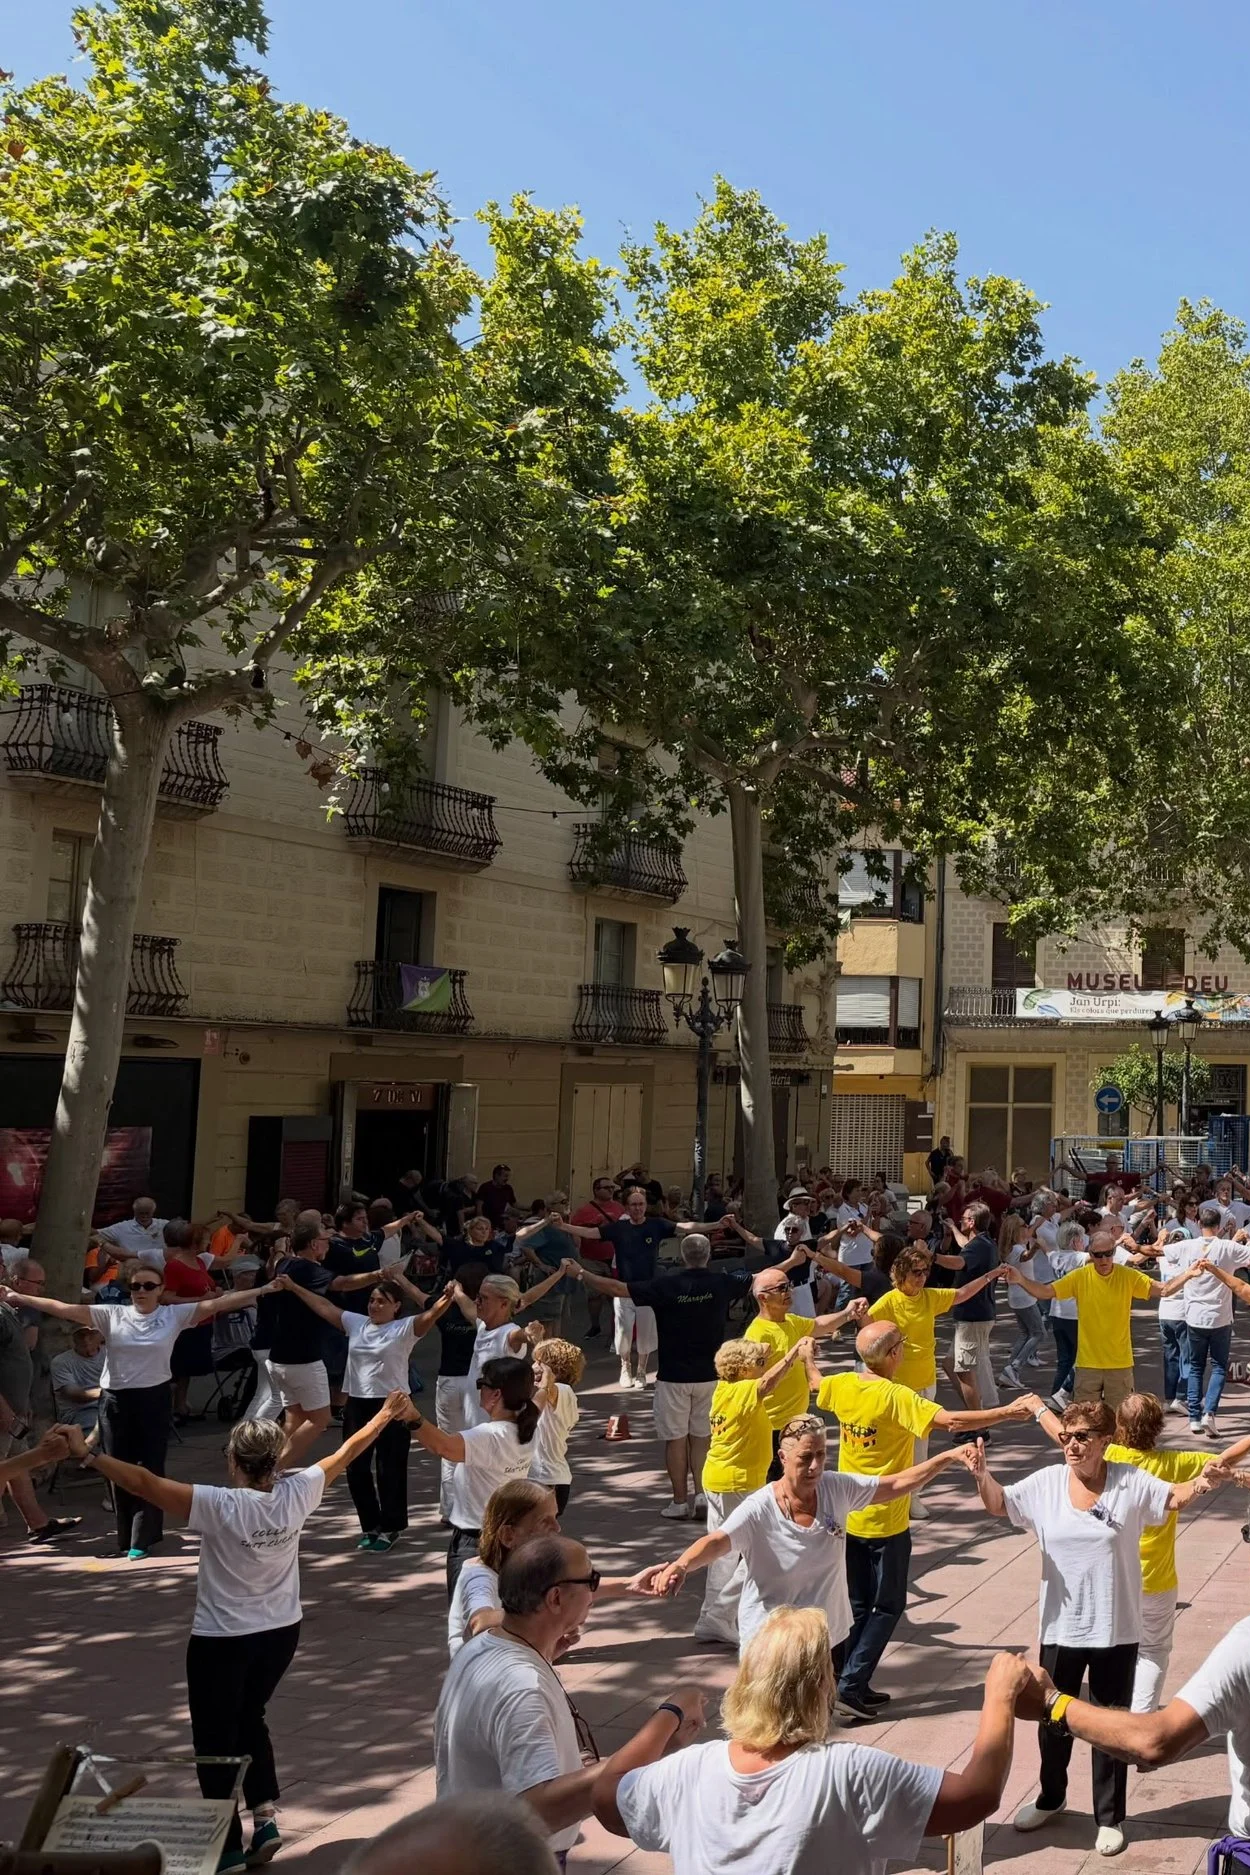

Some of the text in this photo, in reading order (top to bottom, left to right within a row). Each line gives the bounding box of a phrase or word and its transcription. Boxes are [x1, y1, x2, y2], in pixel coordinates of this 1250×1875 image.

[1185, 976, 1228, 992] DEU
[1070, 997, 1090, 1006] Jan
[252, 1526, 287, 1537] COLLA
